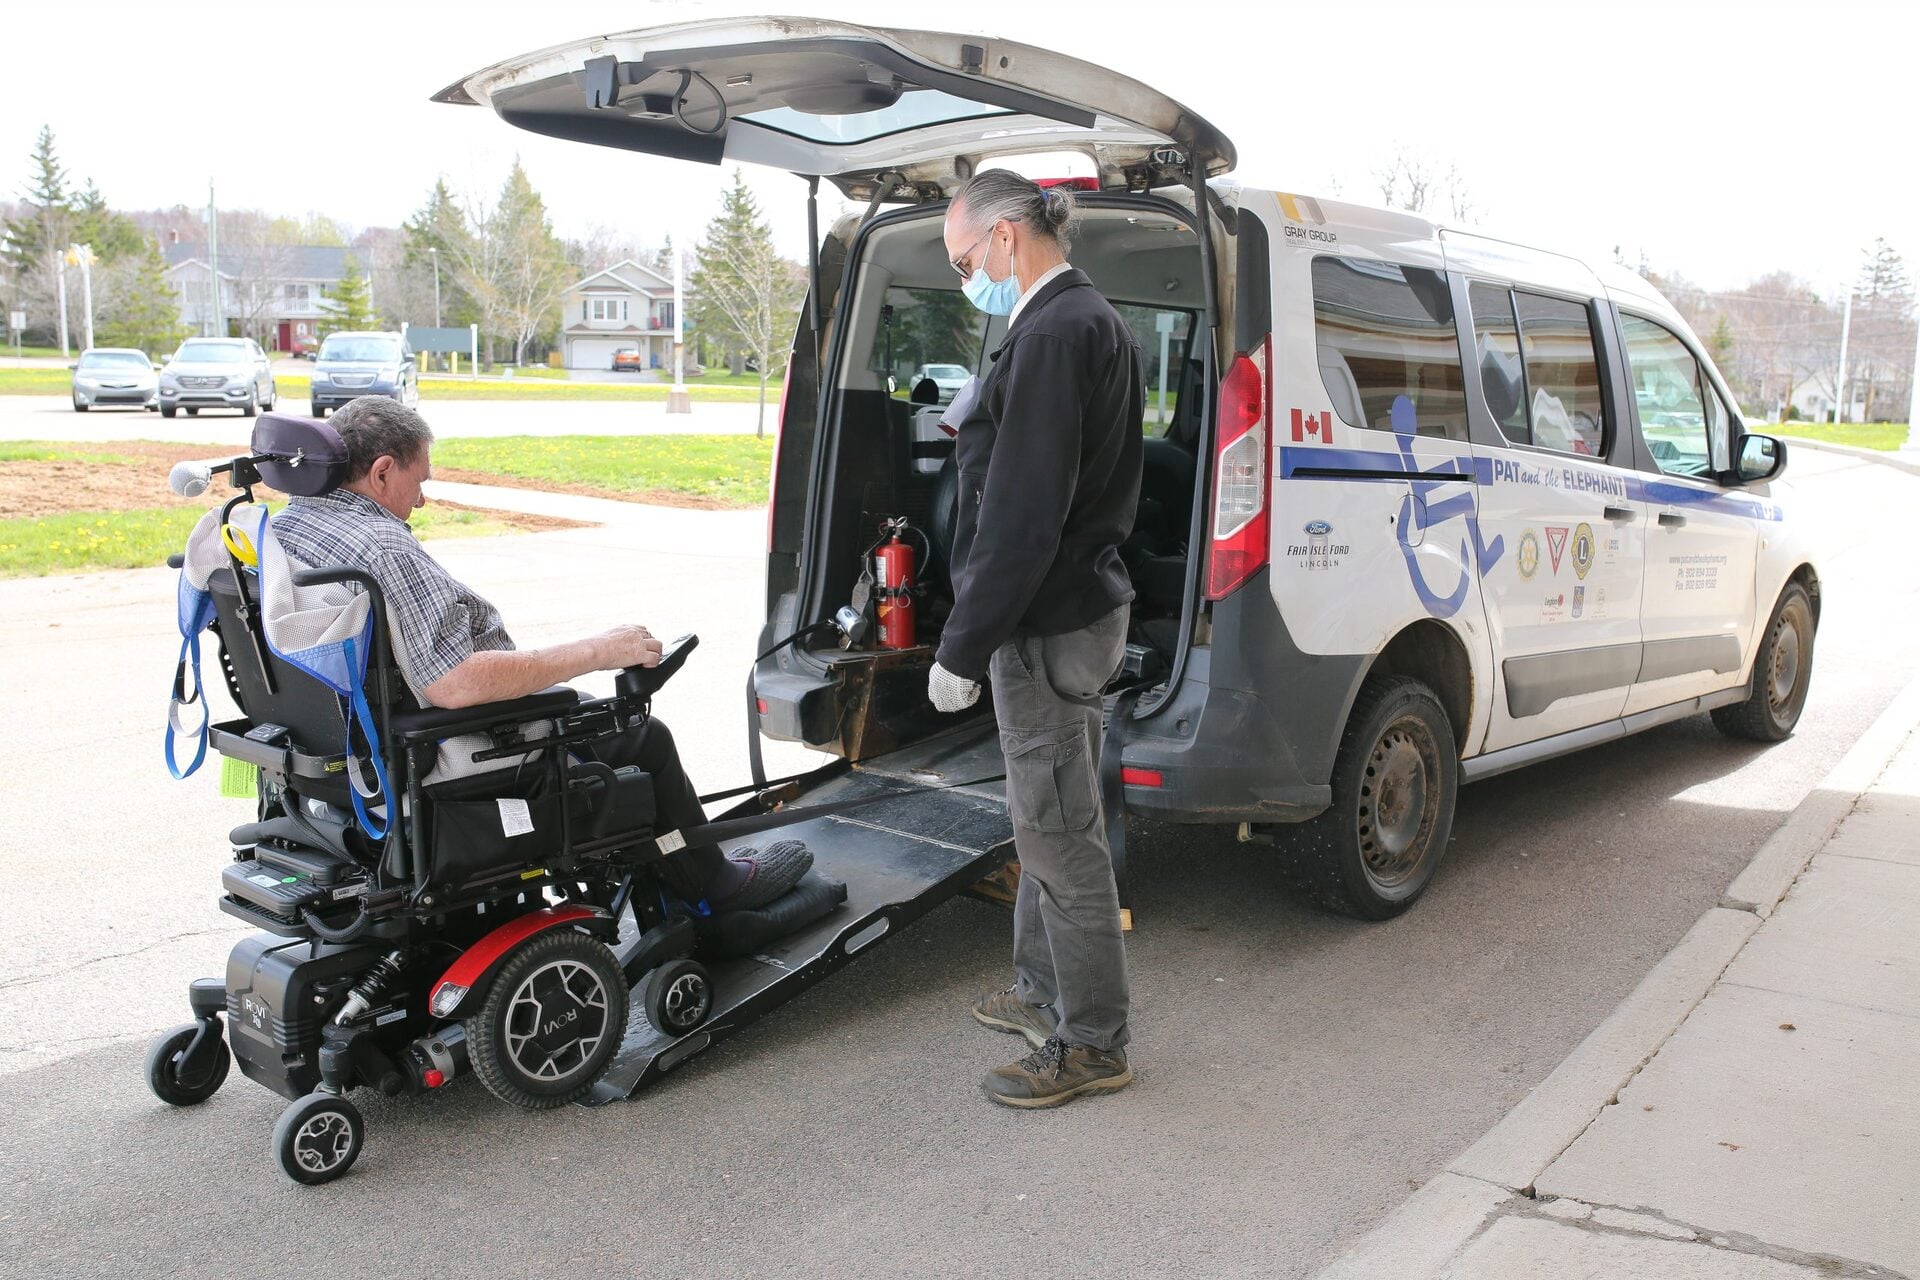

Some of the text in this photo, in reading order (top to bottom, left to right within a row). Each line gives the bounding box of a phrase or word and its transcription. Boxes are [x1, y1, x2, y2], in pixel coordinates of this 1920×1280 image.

[1284, 226, 1337, 243] GRAY GROUP
[1494, 459, 1624, 496] PAT and the ELEPHANT
[1287, 545, 1350, 556] FAIR ISLE FORD
[1300, 560, 1339, 568] LINCOLN
[245, 998, 266, 1019] ROVI
[544, 1008, 578, 1035] ROVI
